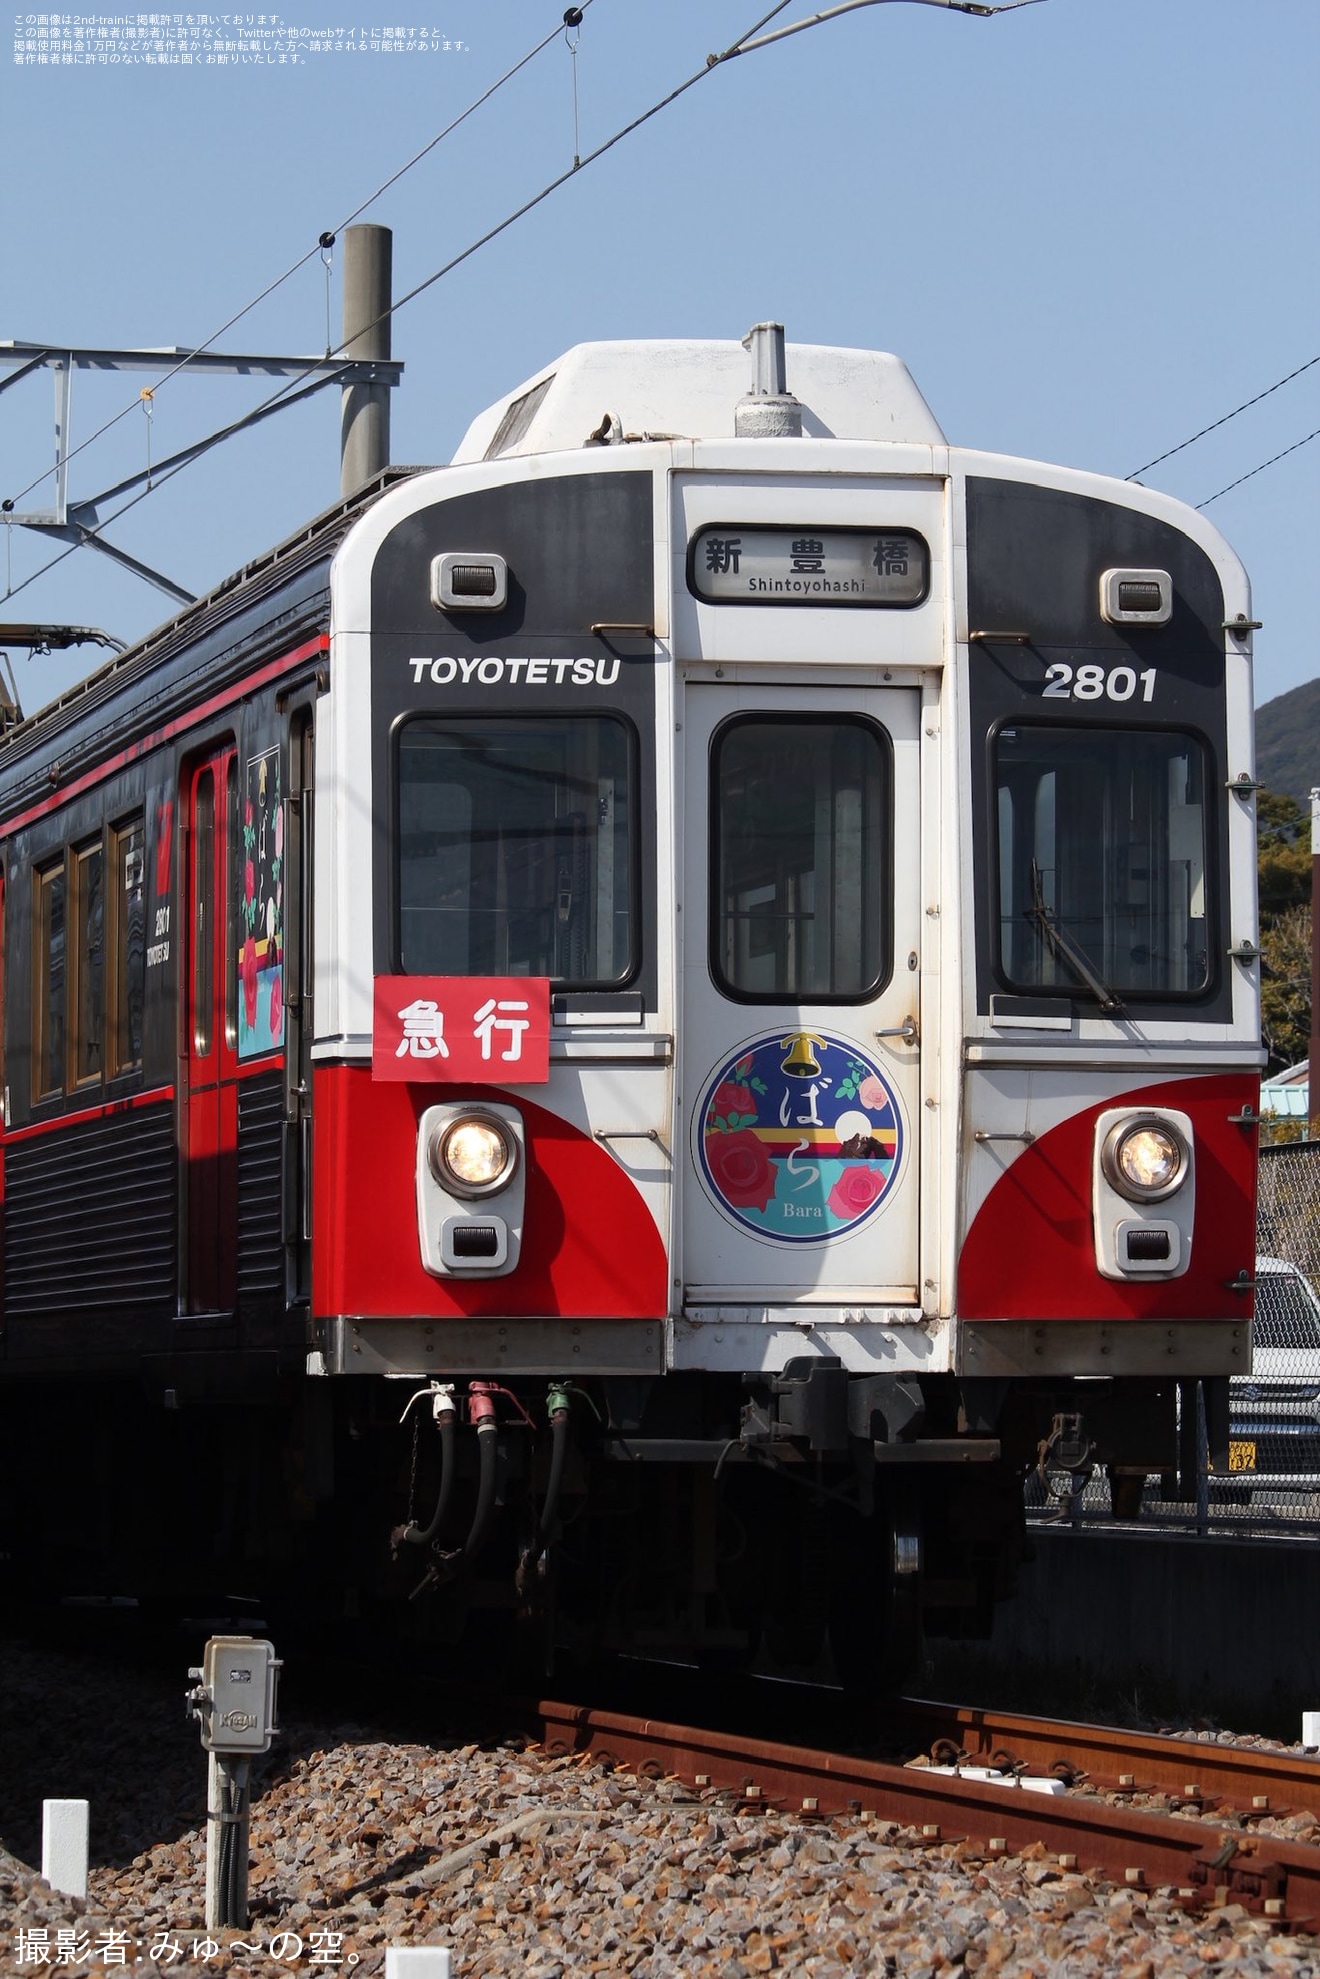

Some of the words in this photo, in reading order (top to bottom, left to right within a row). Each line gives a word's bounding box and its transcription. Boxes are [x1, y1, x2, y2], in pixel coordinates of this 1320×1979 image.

[706, 538, 909, 576] 新豊橋
[749, 578, 866, 594] Shintoyohashi
[409, 657, 621, 685] TOYOTETSU
[1041, 663, 1157, 702] 2801
[395, 999, 530, 1061] 急行
[779, 1077, 833, 1192] ばら
[783, 1203, 822, 1217] Bara
